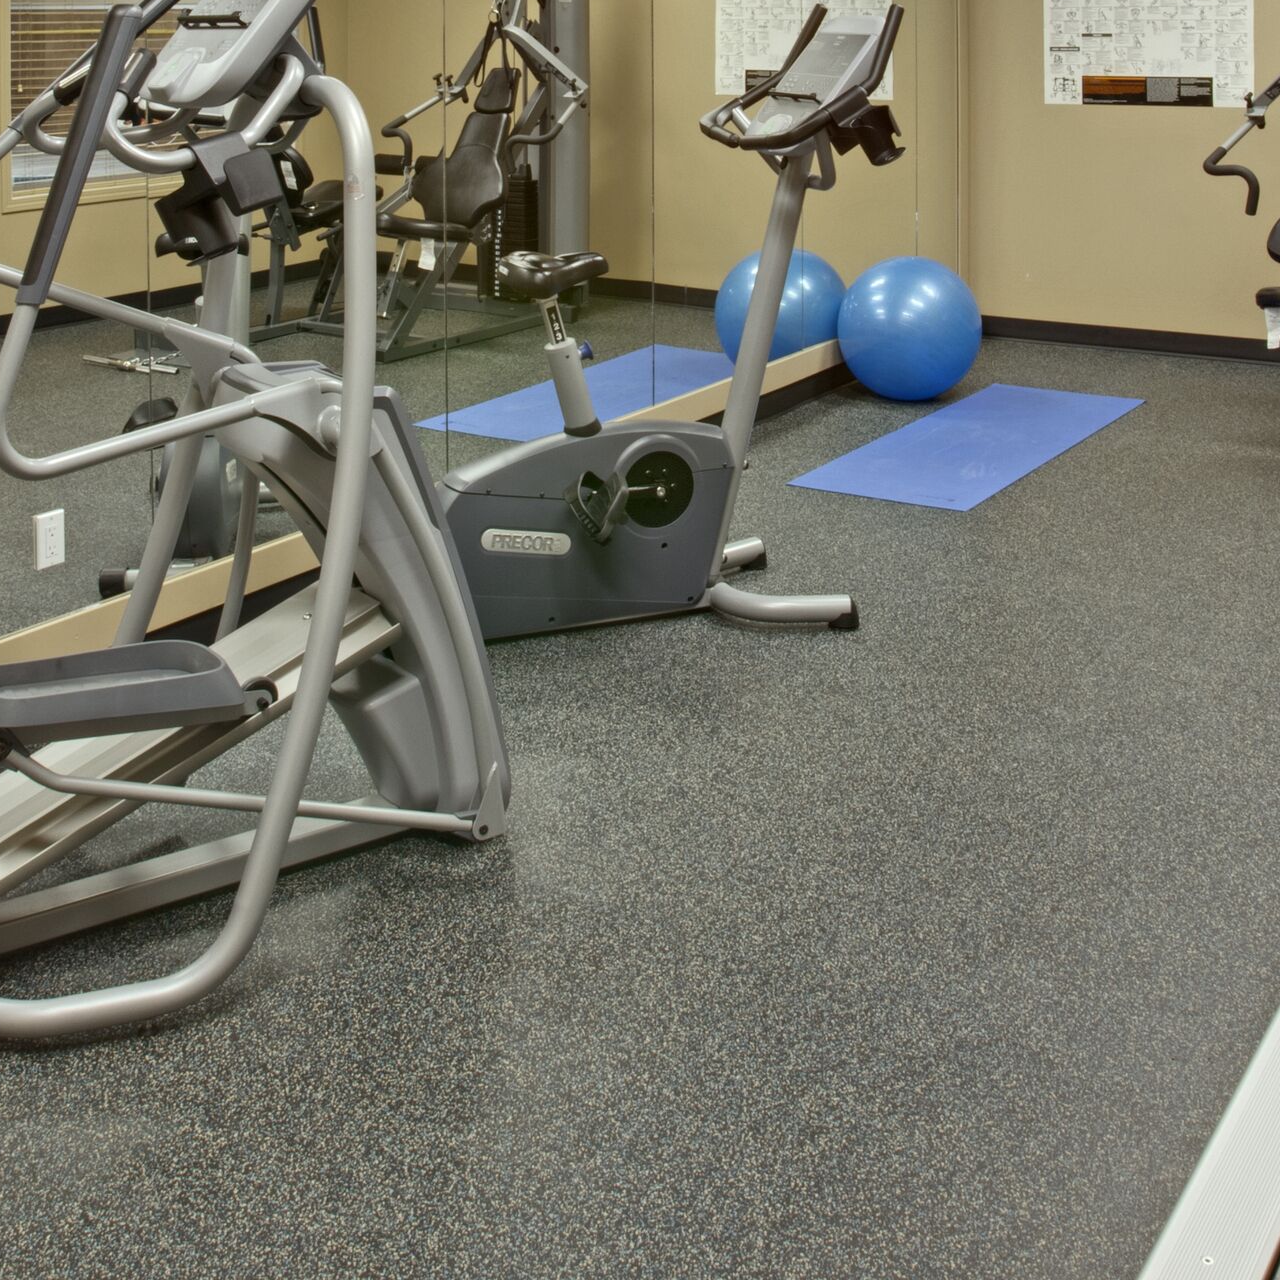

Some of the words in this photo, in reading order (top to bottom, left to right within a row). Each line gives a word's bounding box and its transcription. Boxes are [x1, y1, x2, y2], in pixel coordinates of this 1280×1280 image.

[553, 322, 560, 331] 2
[555, 332, 562, 341] 3
[490, 533, 554, 552] PRECOR
